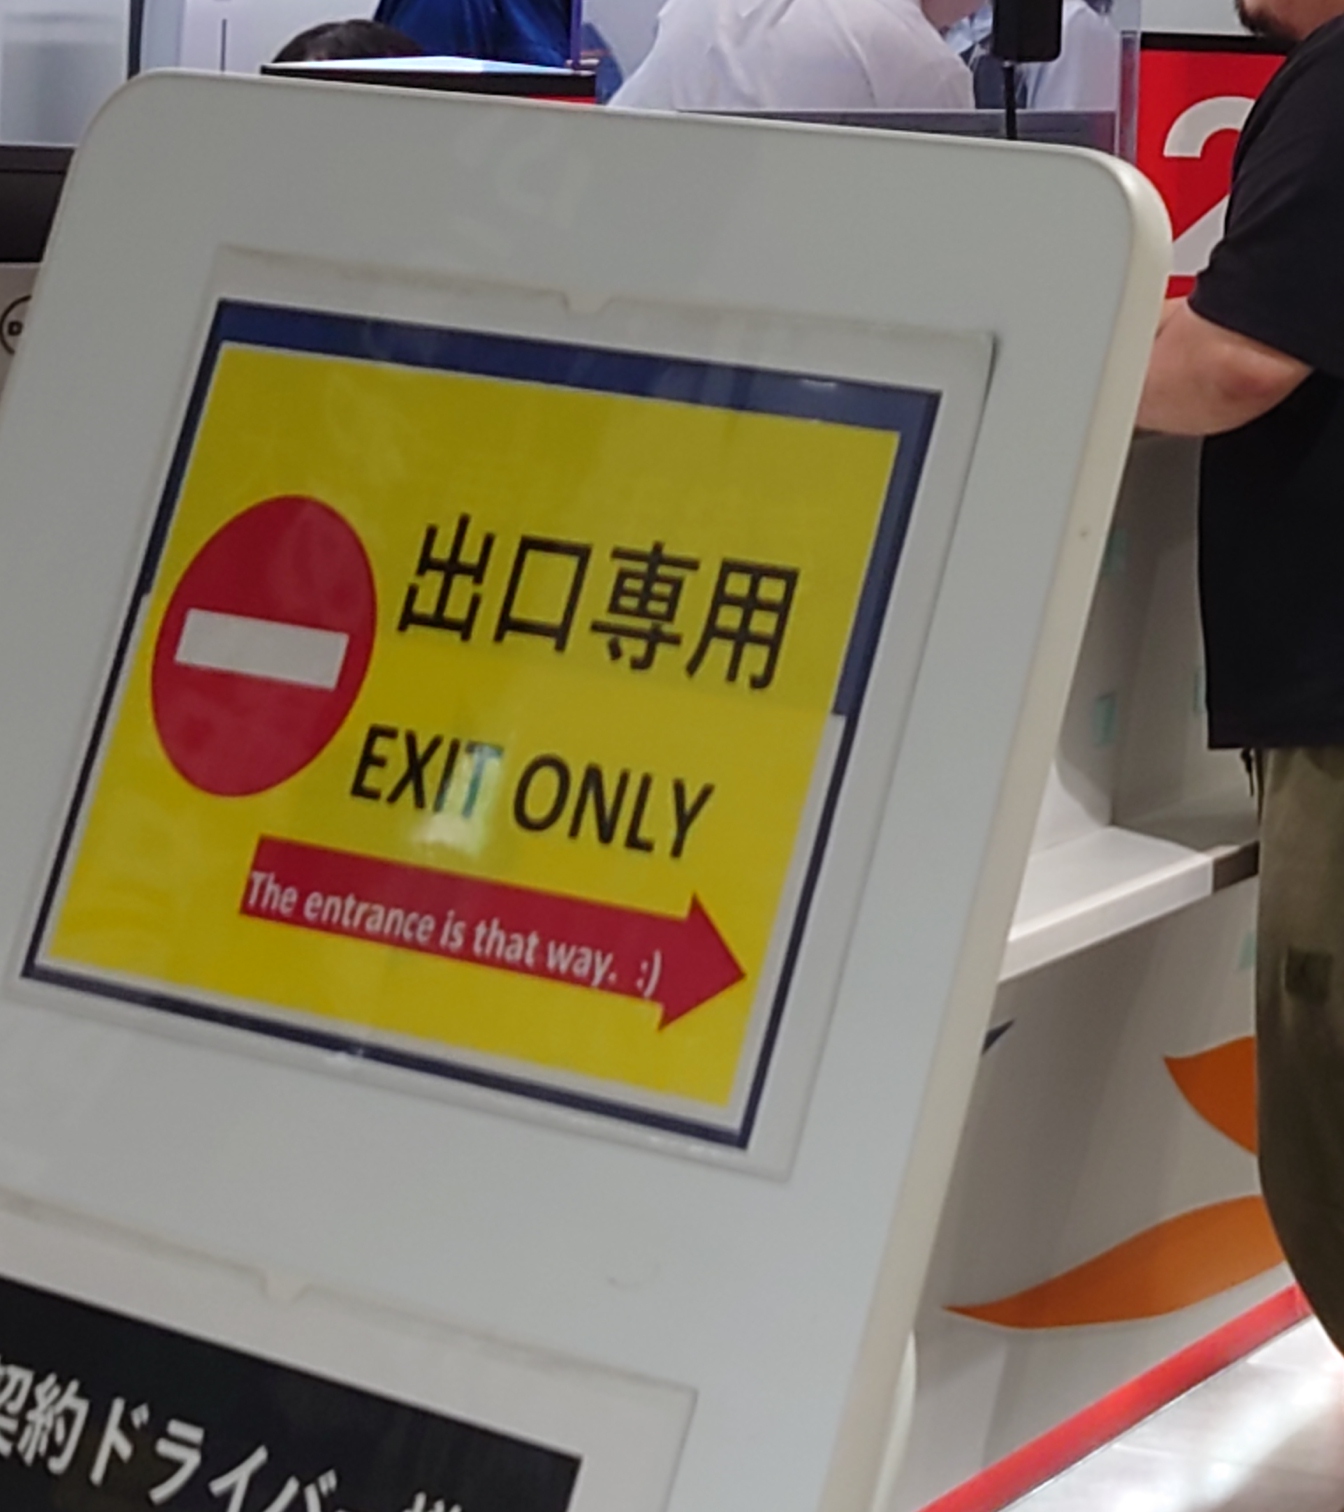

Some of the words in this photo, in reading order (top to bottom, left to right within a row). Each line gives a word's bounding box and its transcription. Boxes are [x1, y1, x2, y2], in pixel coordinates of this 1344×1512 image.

[397, 514, 801, 691] 出口専用
[349, 723, 505, 819] EXIT
[513, 753, 716, 859] ONLY
[246, 871, 298, 916] The
[303, 891, 436, 945] entrance
[439, 909, 466, 951] is
[472, 924, 538, 968] that
[546, 941, 618, 988] way.
[0, 1363, 466, 1512] 契約ドライバ
